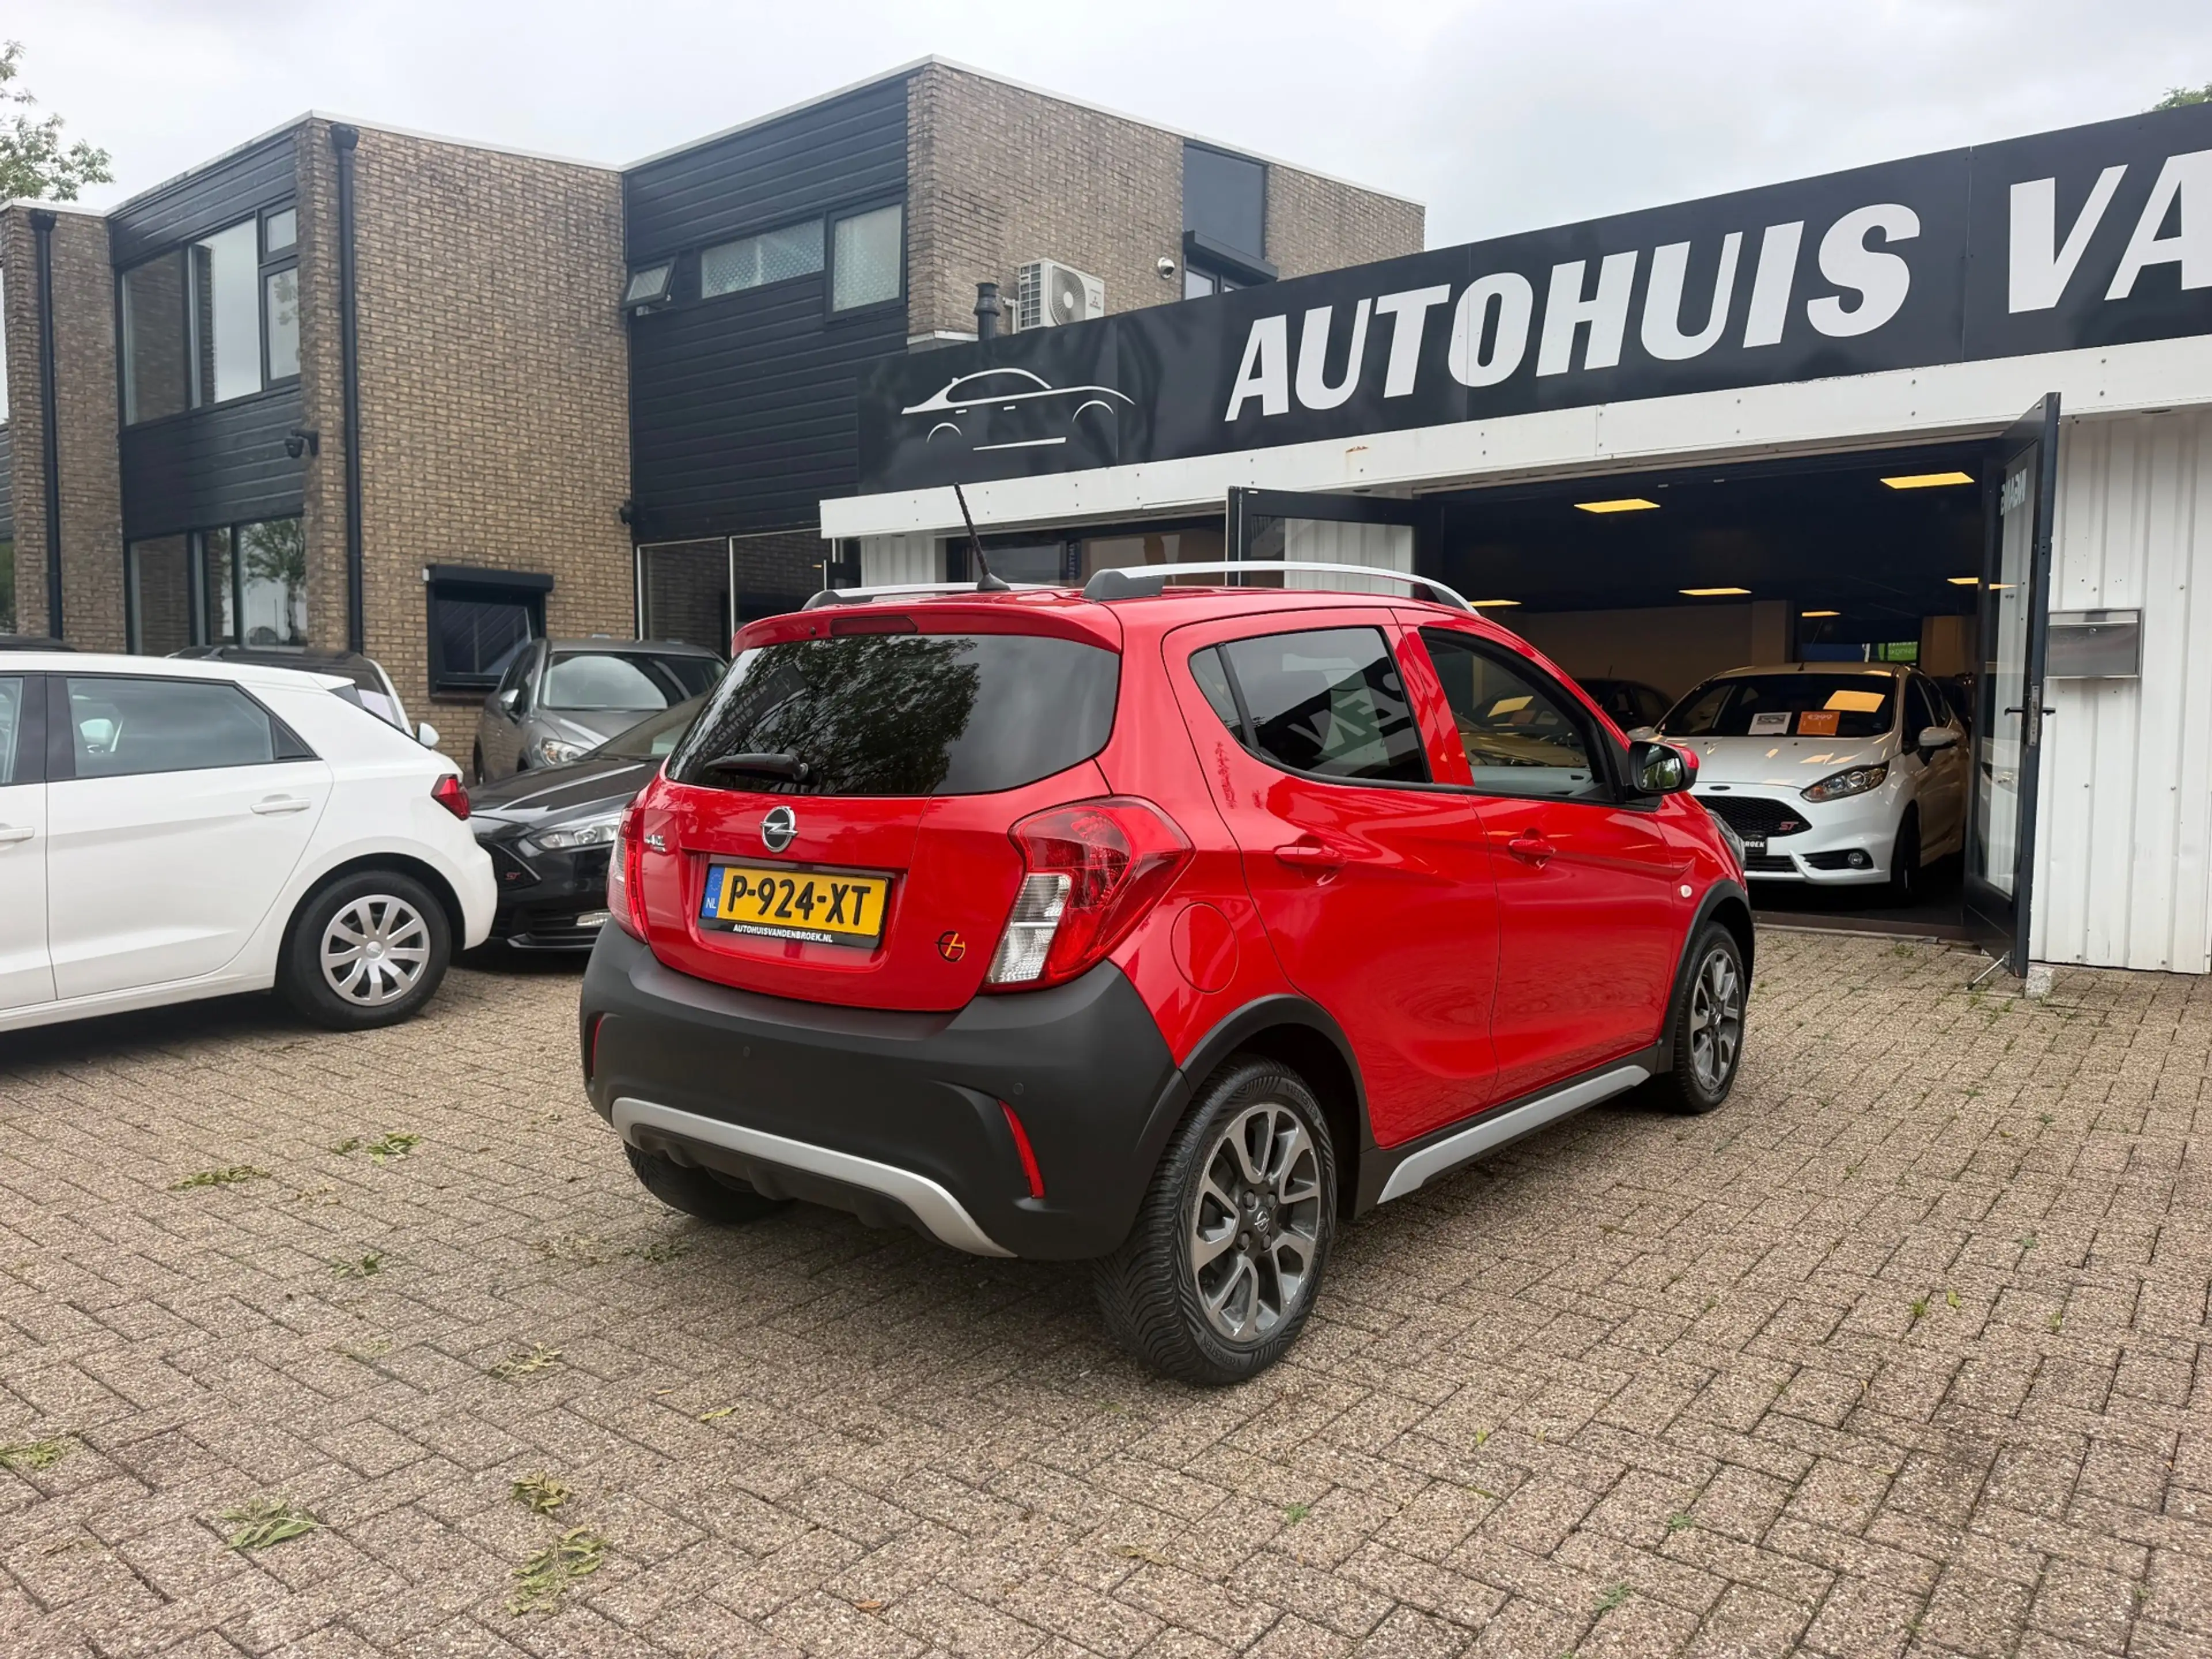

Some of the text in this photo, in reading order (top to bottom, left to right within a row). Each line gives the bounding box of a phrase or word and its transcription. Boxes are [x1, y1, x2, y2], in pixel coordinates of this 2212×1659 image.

[1225, 150, 2212, 422] AUTOHUIS VA
[1779, 821, 1799, 830] ST
[706, 897, 717, 908] NL
[727, 874, 872, 926] P-924-XT
[732, 923, 833, 943] AUTOHUISVANDENBROEK.NL
